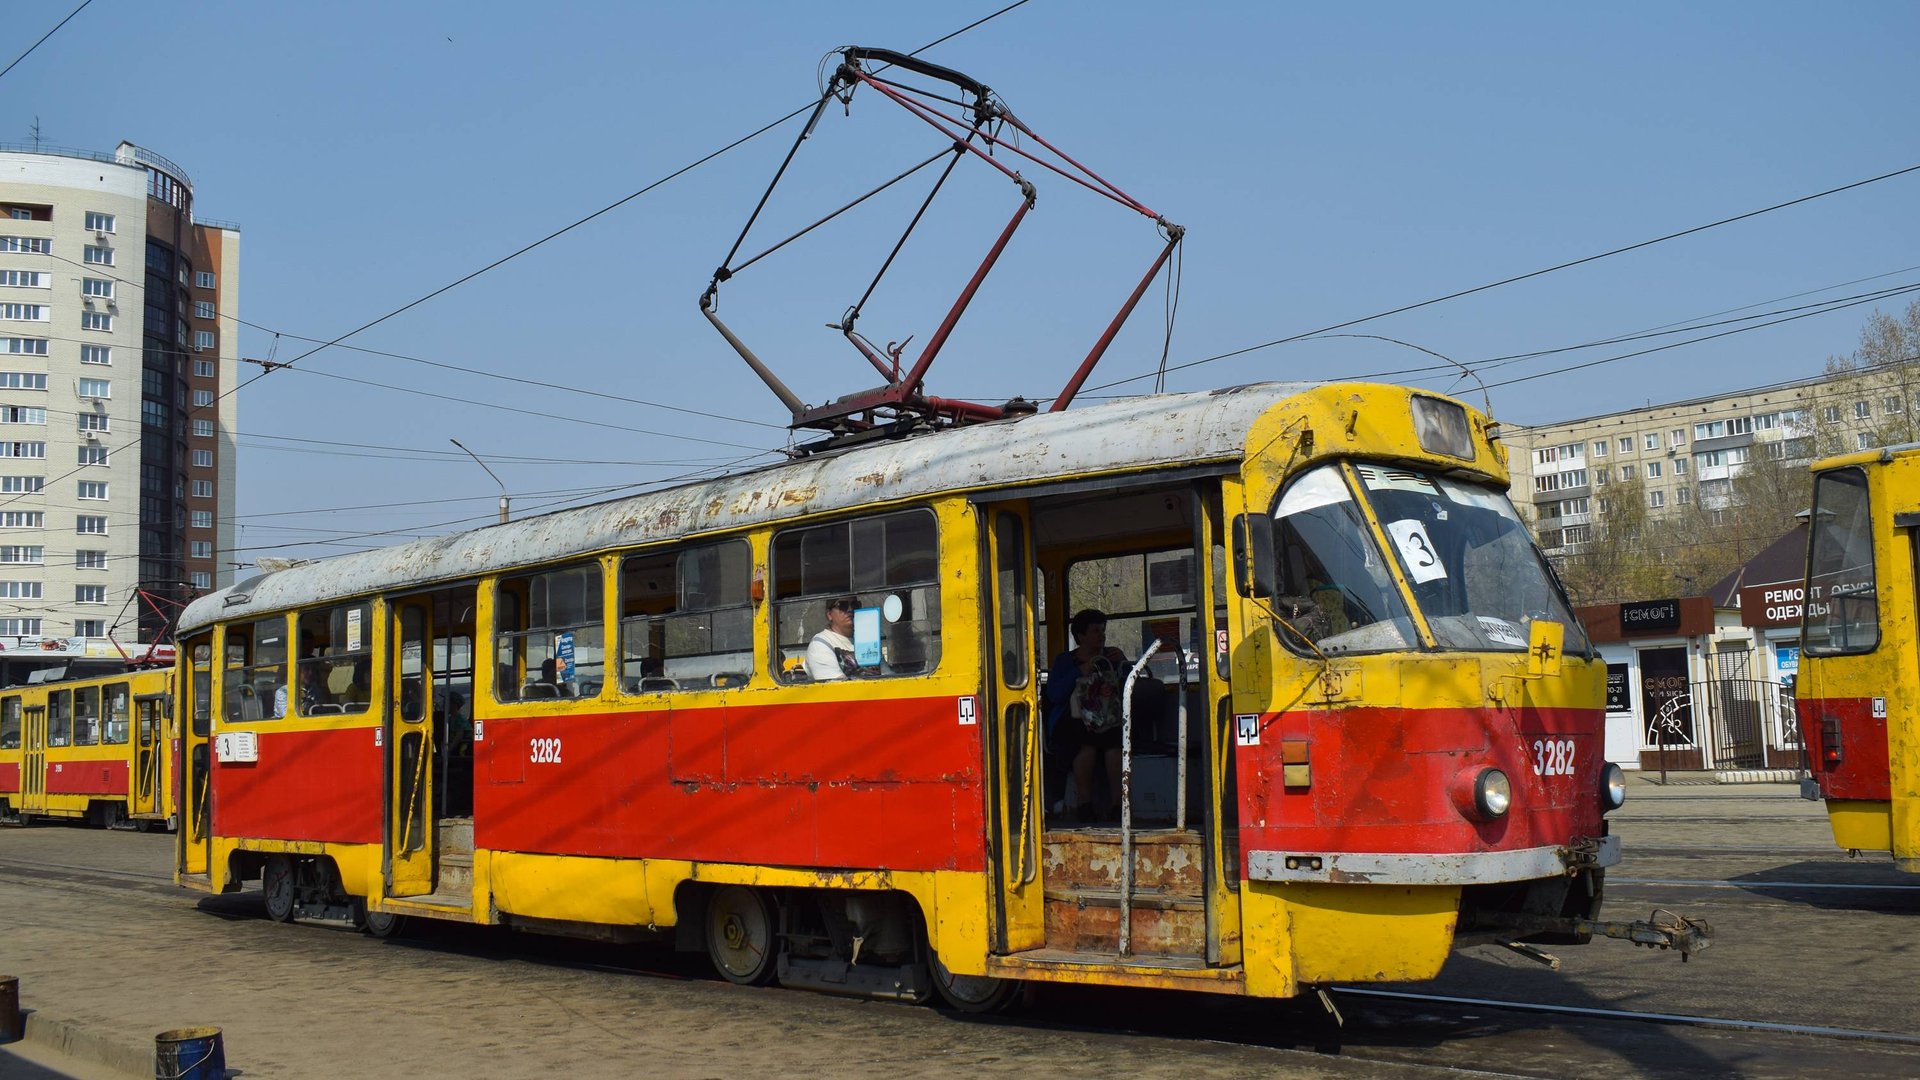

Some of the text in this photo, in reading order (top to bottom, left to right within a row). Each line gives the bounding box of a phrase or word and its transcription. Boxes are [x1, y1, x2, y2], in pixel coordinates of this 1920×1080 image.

[1408, 532, 1435, 567] 3
[1629, 606, 1669, 621] СМОГ
[224, 738, 230, 756] 3
[530, 738, 562, 763] 3282
[1533, 740, 1576, 776] 3282
